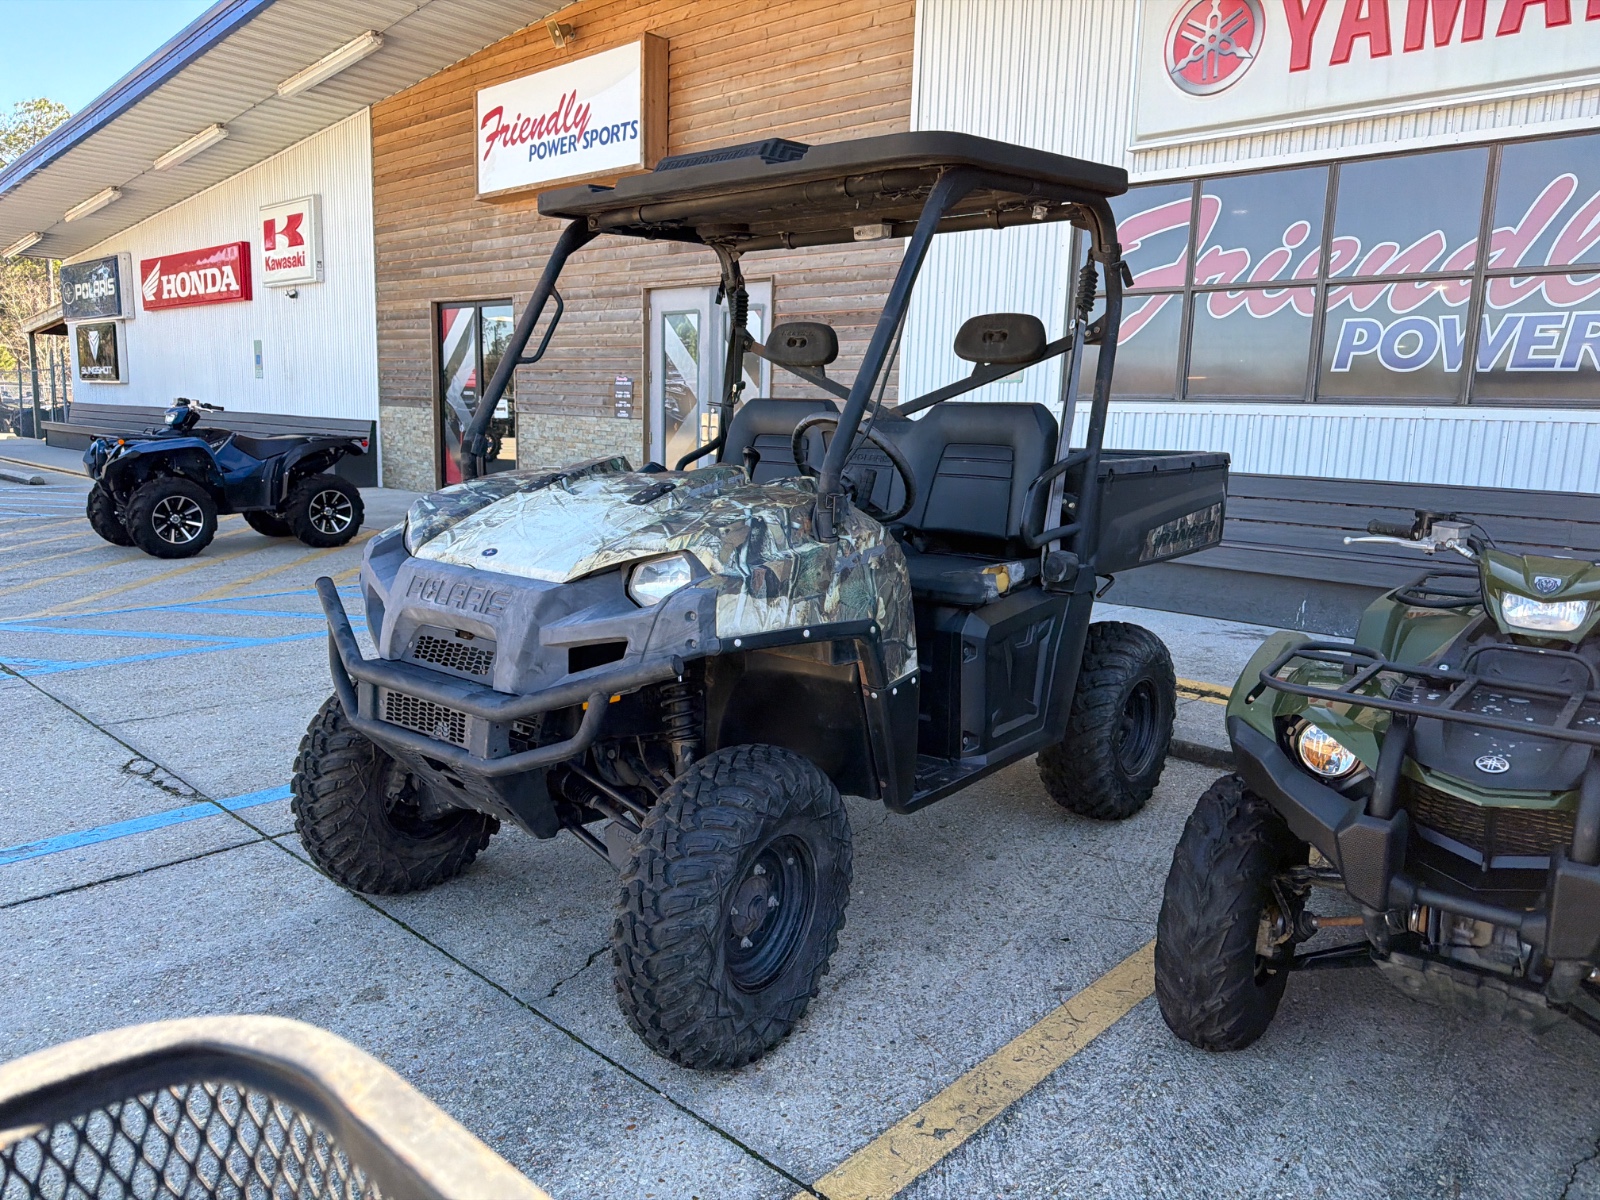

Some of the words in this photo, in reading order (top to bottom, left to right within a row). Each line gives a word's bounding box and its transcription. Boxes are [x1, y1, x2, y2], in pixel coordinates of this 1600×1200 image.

[1283, 0, 1600, 73] YAM
[481, 89, 592, 161] Friendly
[528, 134, 578, 162] POWER
[582, 120, 639, 150] SPORTS
[161, 265, 239, 299] HONDA
[264, 251, 306, 272] Kawasaki
[74, 277, 116, 301] POLARIS
[1330, 310, 1600, 373] POWER
[80, 365, 113, 375] SLINGSHOT
[405, 575, 513, 618] POLARIS
